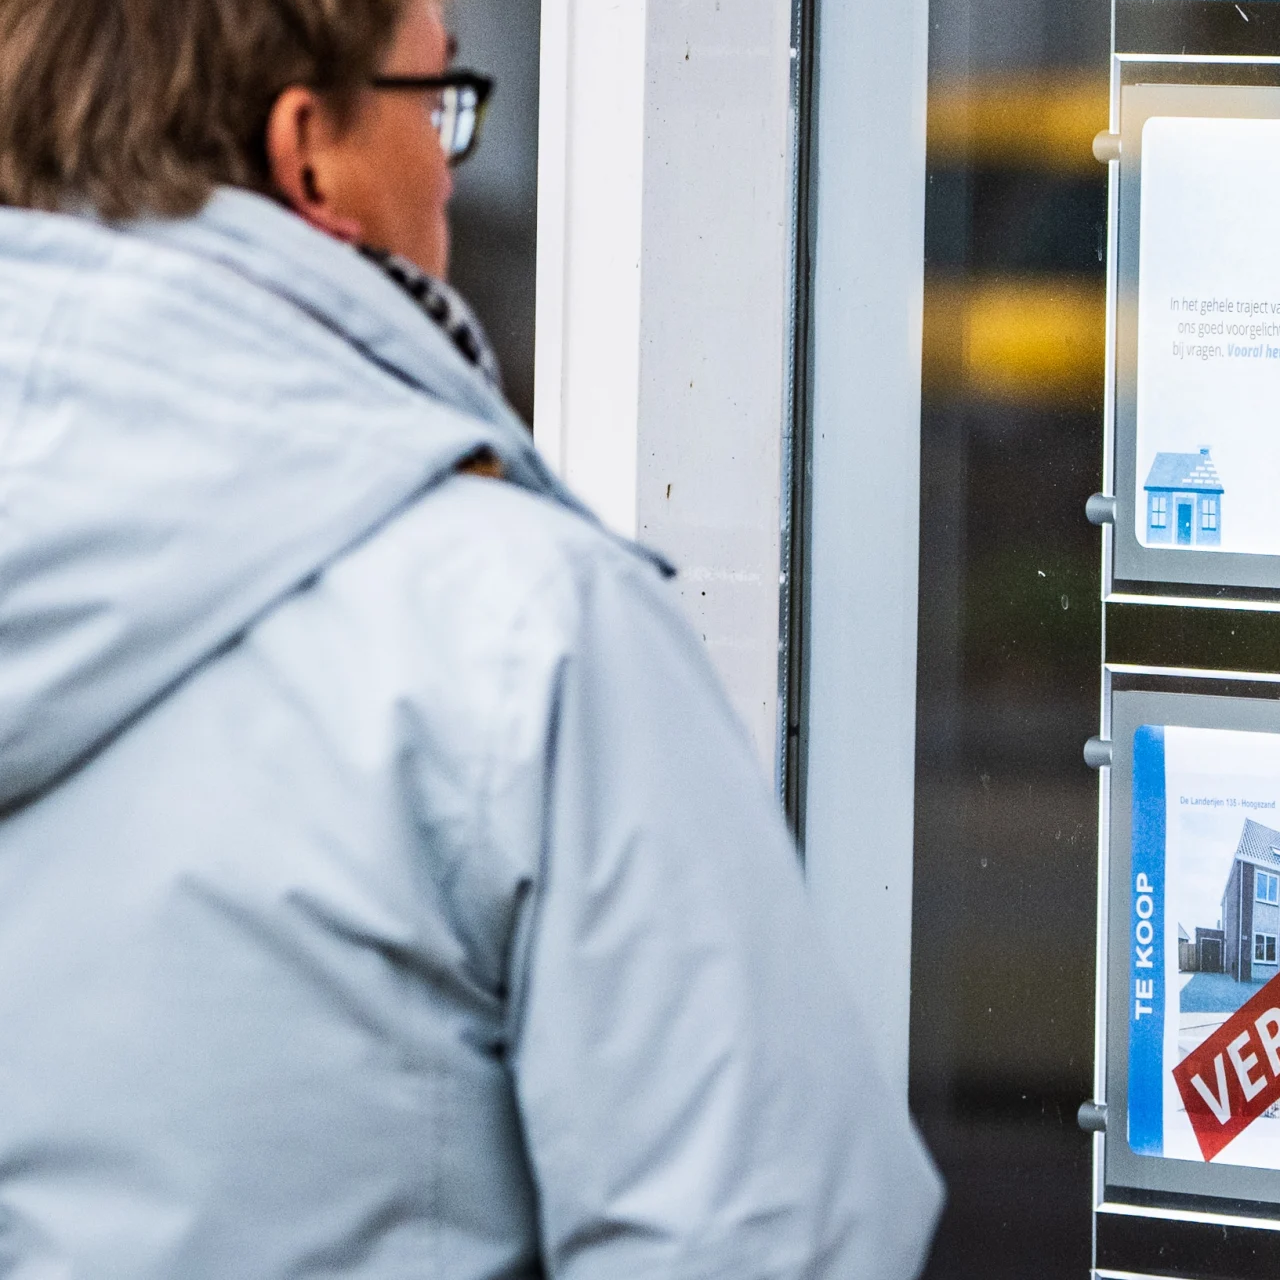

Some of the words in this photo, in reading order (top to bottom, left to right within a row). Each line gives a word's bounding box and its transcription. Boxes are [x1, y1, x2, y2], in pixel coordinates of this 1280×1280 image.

[1171, 297, 1179, 311] In
[1183, 296, 1198, 311] het
[1200, 297, 1233, 315] gehele
[1237, 300, 1268, 317] traject
[1178, 322, 1195, 333] ons
[1198, 321, 1224, 338] goed
[1173, 341, 1183, 360] bij
[1186, 344, 1224, 360] vragen.
[1228, 343, 1263, 358] Vooral
[1180, 796, 1188, 804] De
[1242, 800, 1276, 810] Hoogezand
[1136, 872, 1153, 968] KOOP
[1135, 979, 1153, 1020] TE
